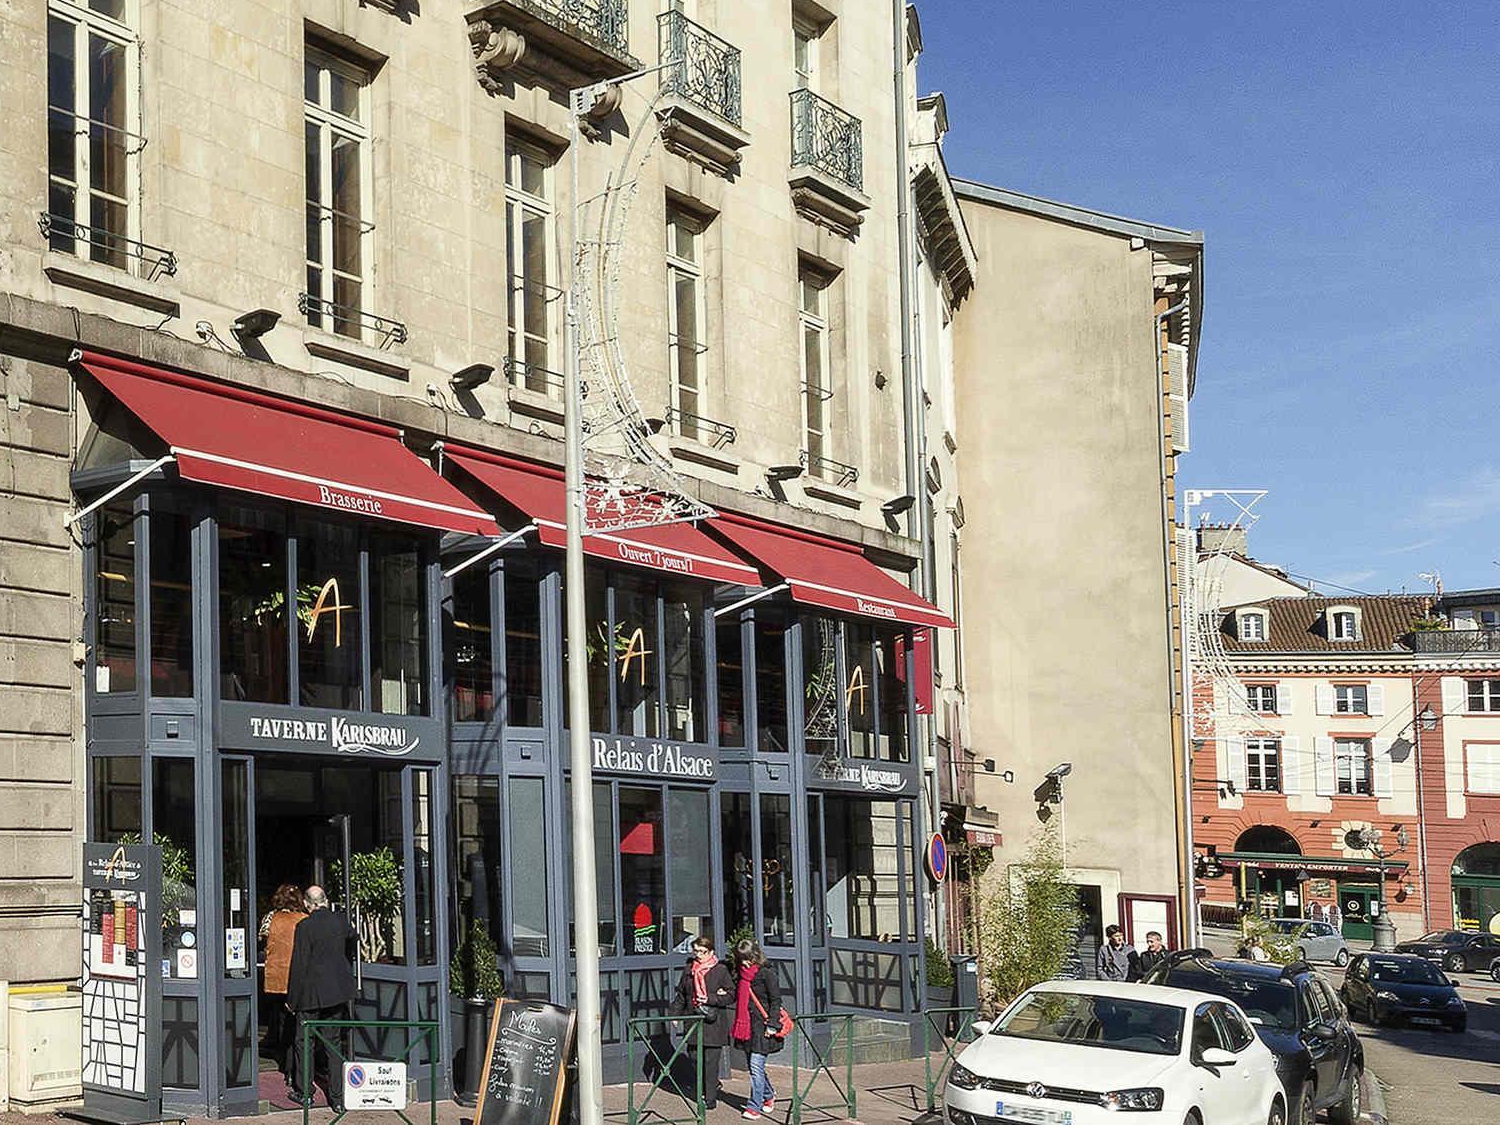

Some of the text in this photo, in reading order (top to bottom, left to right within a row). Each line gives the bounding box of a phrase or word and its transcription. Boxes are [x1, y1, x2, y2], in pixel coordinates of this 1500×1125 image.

[318, 485, 382, 513] Brasserie
[618, 542, 654, 564] Ouvert
[250, 718, 327, 741] TAVERNE
[592, 738, 713, 777] Relais d'Alsace
[378, 1066, 392, 1075] Sauf
